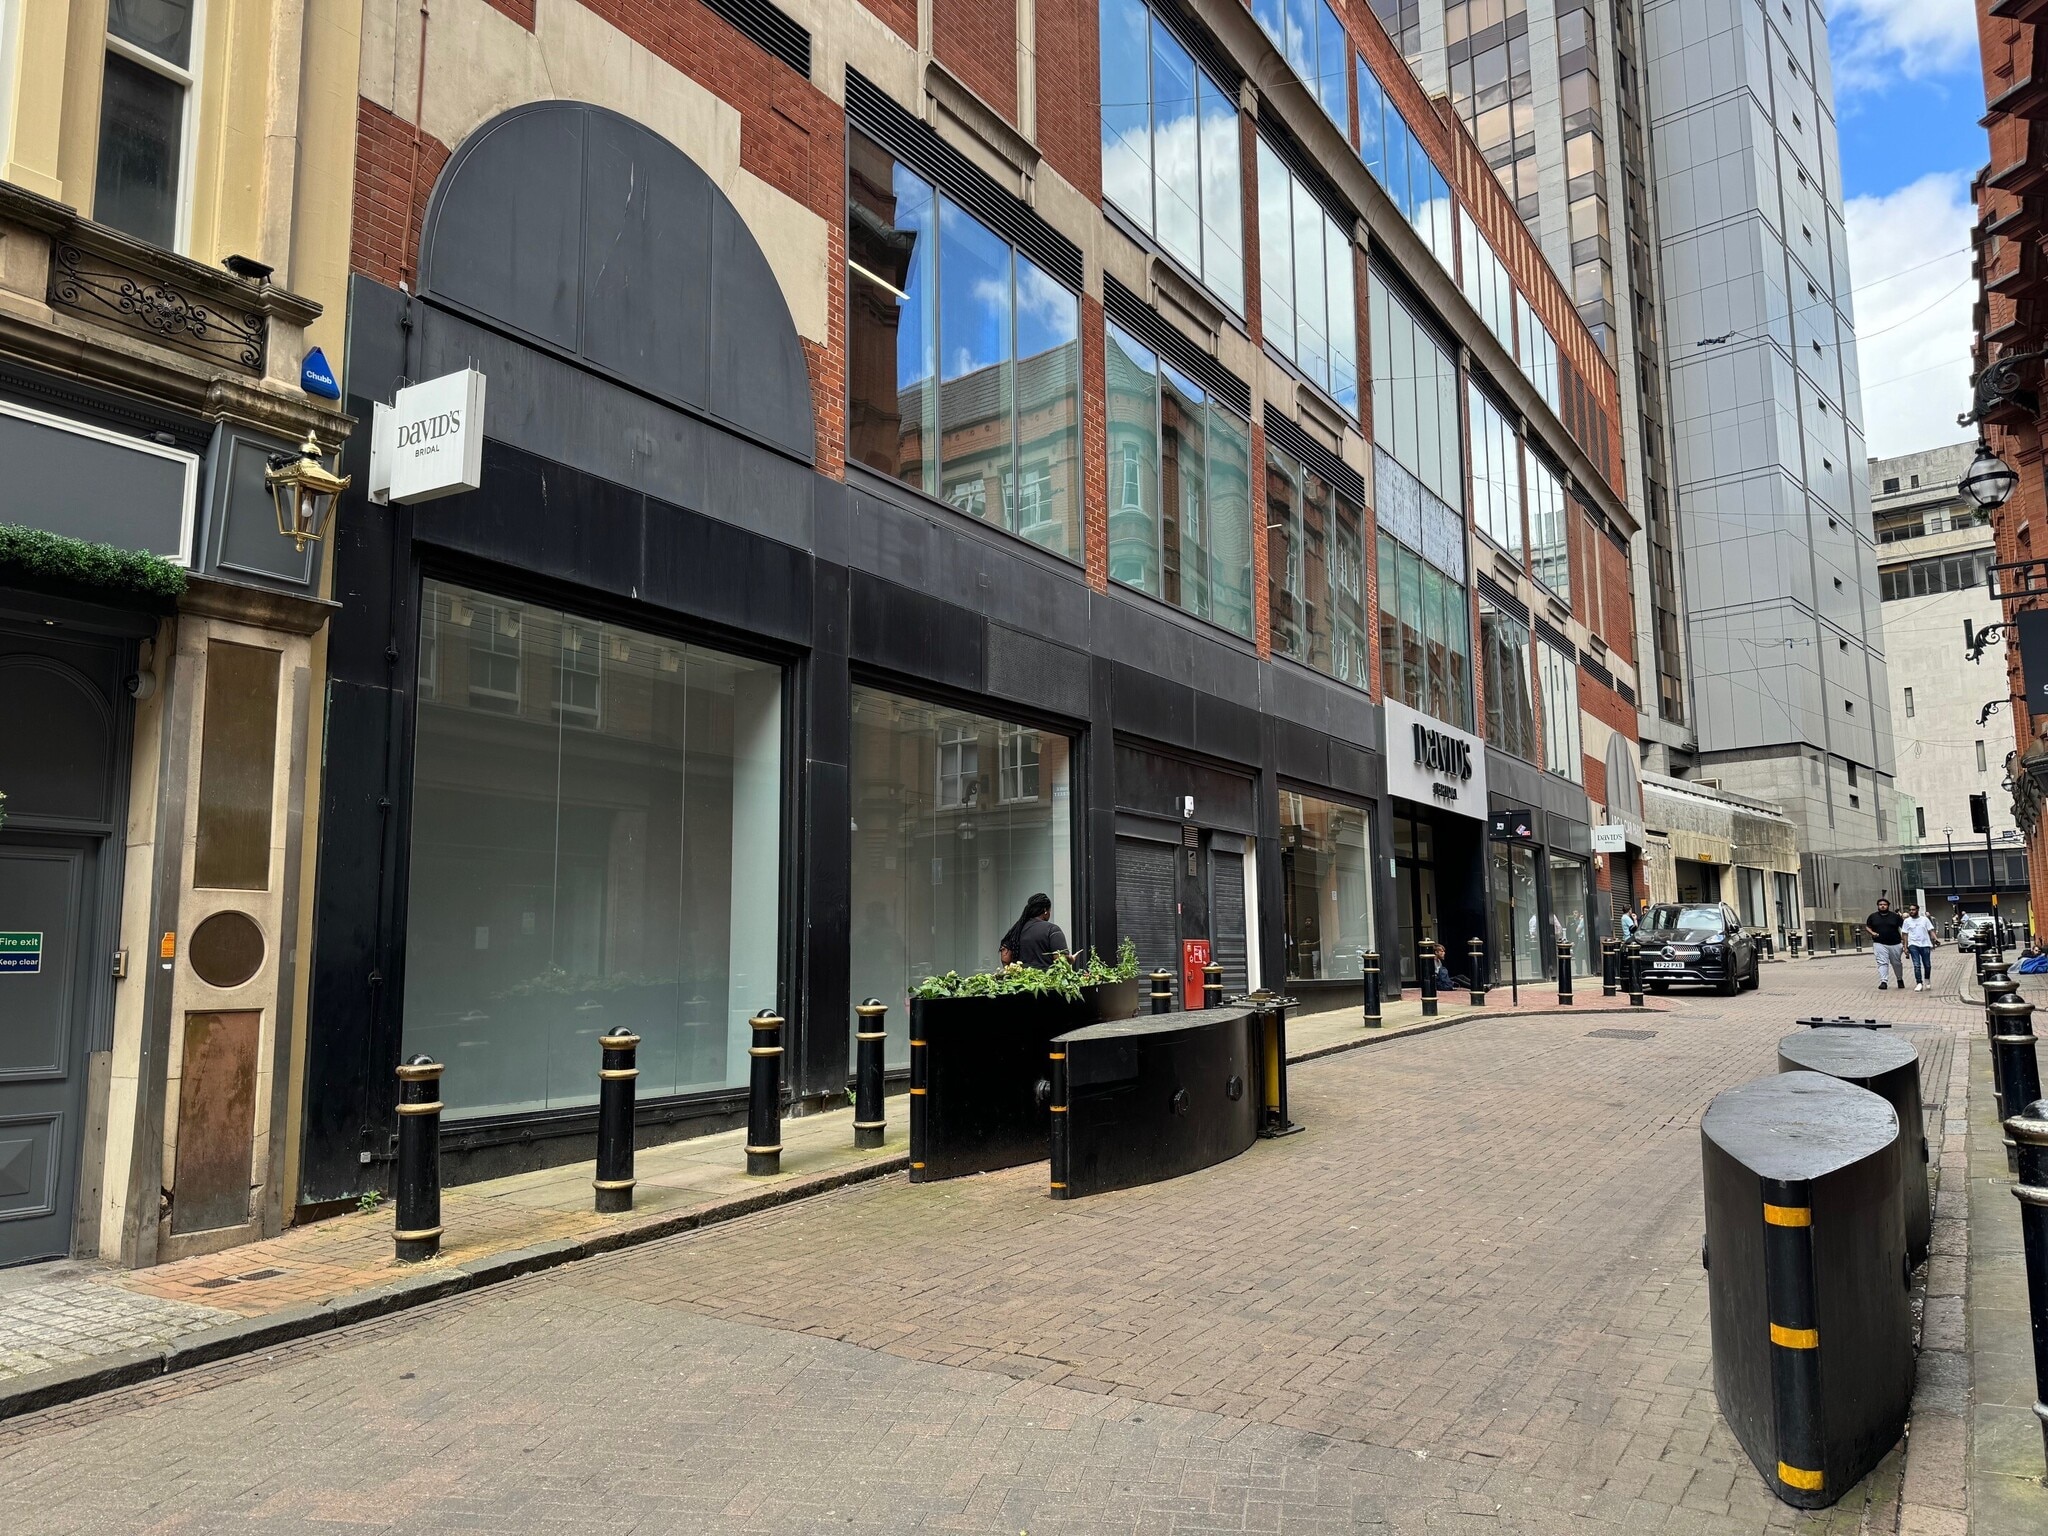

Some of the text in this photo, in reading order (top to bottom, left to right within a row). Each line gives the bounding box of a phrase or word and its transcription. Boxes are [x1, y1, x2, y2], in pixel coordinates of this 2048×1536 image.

[306, 370, 332, 385] Chubb
[414, 444, 440, 458] BRIDAL
[0, 937, 38, 946] Fire exit
[19, 958, 38, 966] clear
